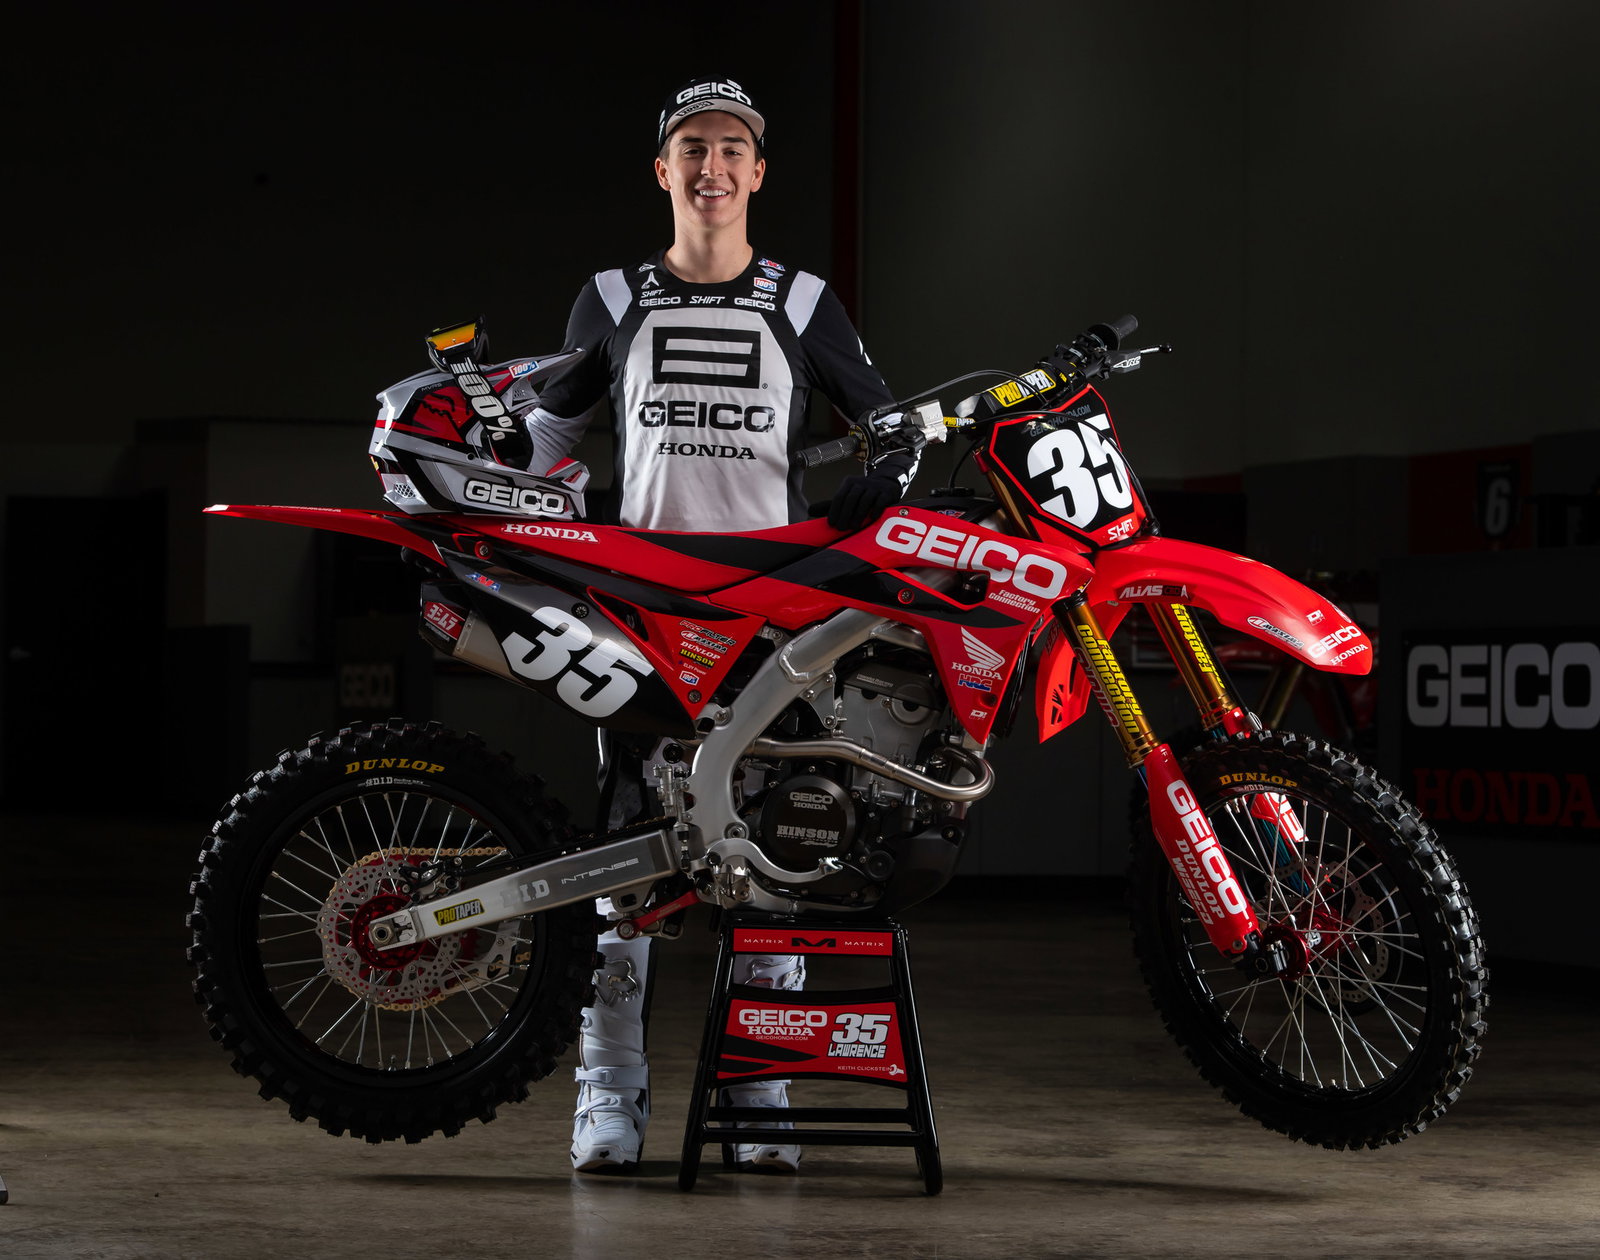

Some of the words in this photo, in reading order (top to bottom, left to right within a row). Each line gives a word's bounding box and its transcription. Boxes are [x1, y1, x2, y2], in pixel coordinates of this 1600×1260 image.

[641, 289, 665, 298] SHIFT
[756, 279, 775, 290] 100%
[639, 296, 681, 307] GEICO
[689, 295, 725, 305] SHIFT
[734, 297, 777, 311] GEICO
[751, 290, 776, 301] SHIFT
[512, 361, 537, 376] 100%
[450, 356, 517, 441] 100%
[638, 400, 776, 433] GEICO
[658, 442, 757, 460] HONDA
[1026, 413, 1133, 529] 35
[466, 480, 567, 513] GEICO
[1485, 476, 1513, 537] 6
[503, 523, 599, 543] HONDA
[875, 516, 1068, 600] GEICO
[680, 641, 721, 660] DUNLOP
[1307, 625, 1361, 658] GEICO
[500, 606, 655, 718] 35
[680, 648, 715, 668] HINSON
[1331, 643, 1369, 666] HONDA
[951, 661, 1003, 681] HONDA
[958, 673, 993, 692] HRC
[1407, 642, 1600, 730] GEICO
[344, 758, 446, 775] DUNLOP
[1219, 772, 1298, 788] DUNLOP
[789, 791, 834, 805] GEICO
[793, 801, 829, 811] HONDA
[1413, 767, 1600, 828] HONDA
[777, 825, 840, 841] HINSON
[1165, 779, 1250, 917] GEICO
[561, 857, 640, 885] INTENSE
[1175, 839, 1226, 919] DUNLOP
[437, 901, 482, 925] PROTAPER
[739, 1008, 828, 1028] GEICO
[746, 1026, 816, 1036] HONDA
[831, 1012, 892, 1045] 35
[827, 1043, 887, 1059] LAWRENCE
